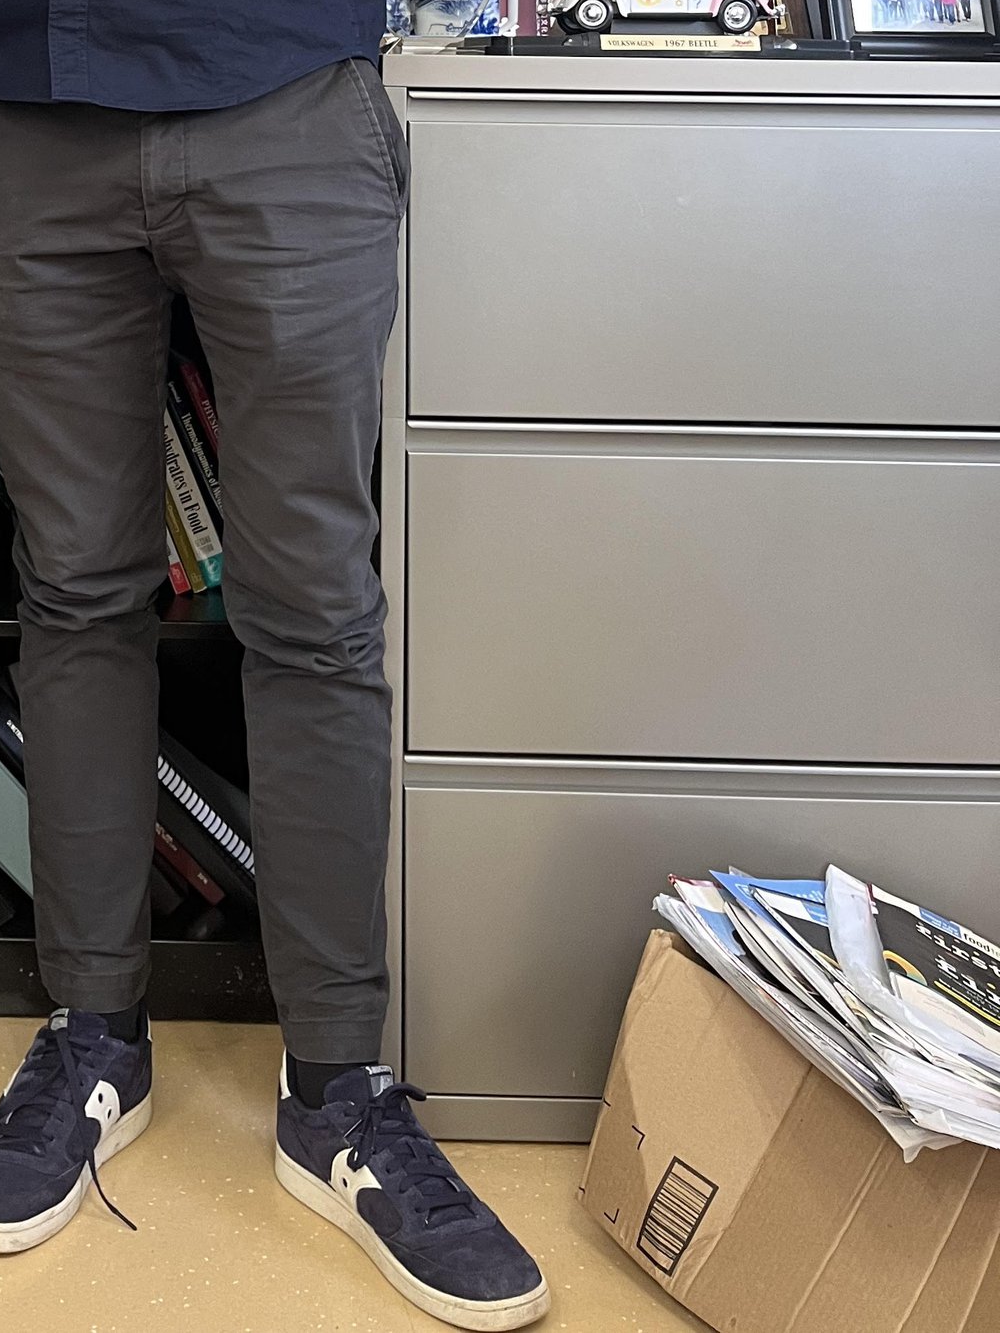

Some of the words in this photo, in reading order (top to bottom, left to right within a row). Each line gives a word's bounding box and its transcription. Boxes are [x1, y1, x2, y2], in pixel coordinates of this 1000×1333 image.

[181, 412, 215, 478] Thermodynamics
[178, 489, 194, 504] in
[183, 503, 208, 535] Food
